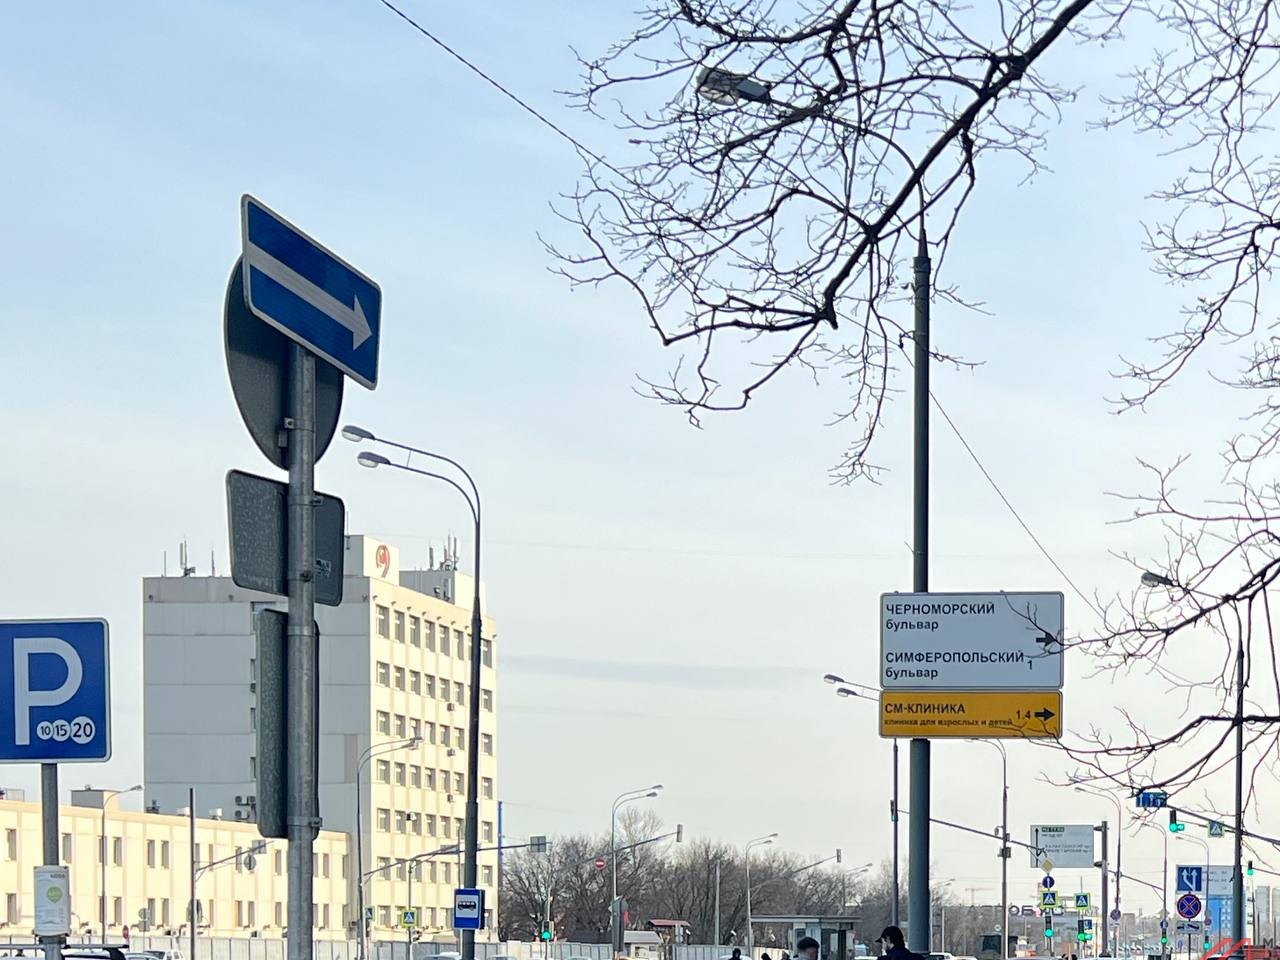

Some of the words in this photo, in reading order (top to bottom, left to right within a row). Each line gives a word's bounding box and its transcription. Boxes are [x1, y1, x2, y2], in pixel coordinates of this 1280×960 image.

[886, 602, 995, 615] ЧЕРНОМОРСКИЙ
[886, 619, 939, 632] бульвар
[886, 651, 1024, 663] СИМФЕРОПОЛЬСКИЙ
[886, 667, 939, 680] бульвар
[13, 637, 83, 746] P
[885, 703, 965, 714] СМ-КЛИНИКА
[1016, 710, 1031, 720] 1.4
[40, 725, 51, 737] 10
[55, 724, 68, 737] 15
[72, 722, 93, 738] 20
